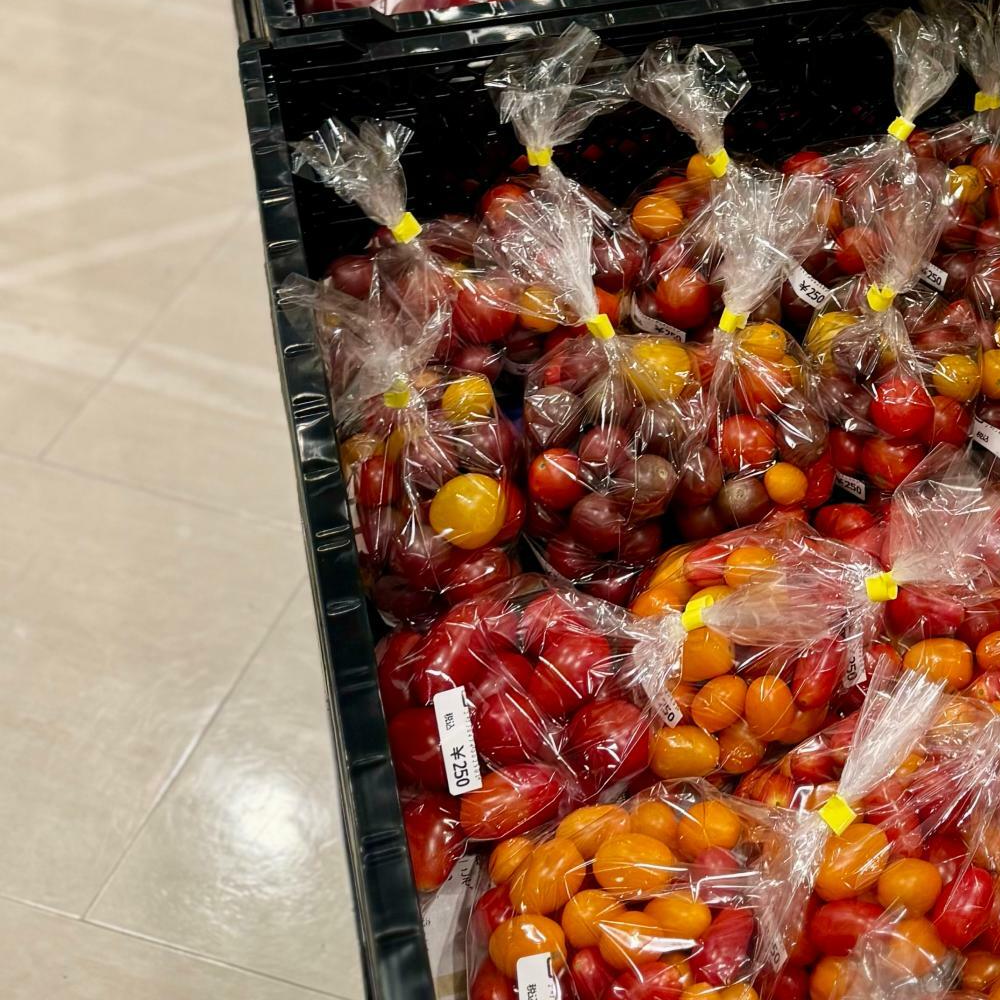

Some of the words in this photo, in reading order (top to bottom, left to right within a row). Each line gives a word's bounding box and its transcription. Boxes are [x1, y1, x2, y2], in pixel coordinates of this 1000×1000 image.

[922, 269, 943, 286] 250
[799, 279, 825, 304] ¥250
[450, 744, 471, 788] ¥250
